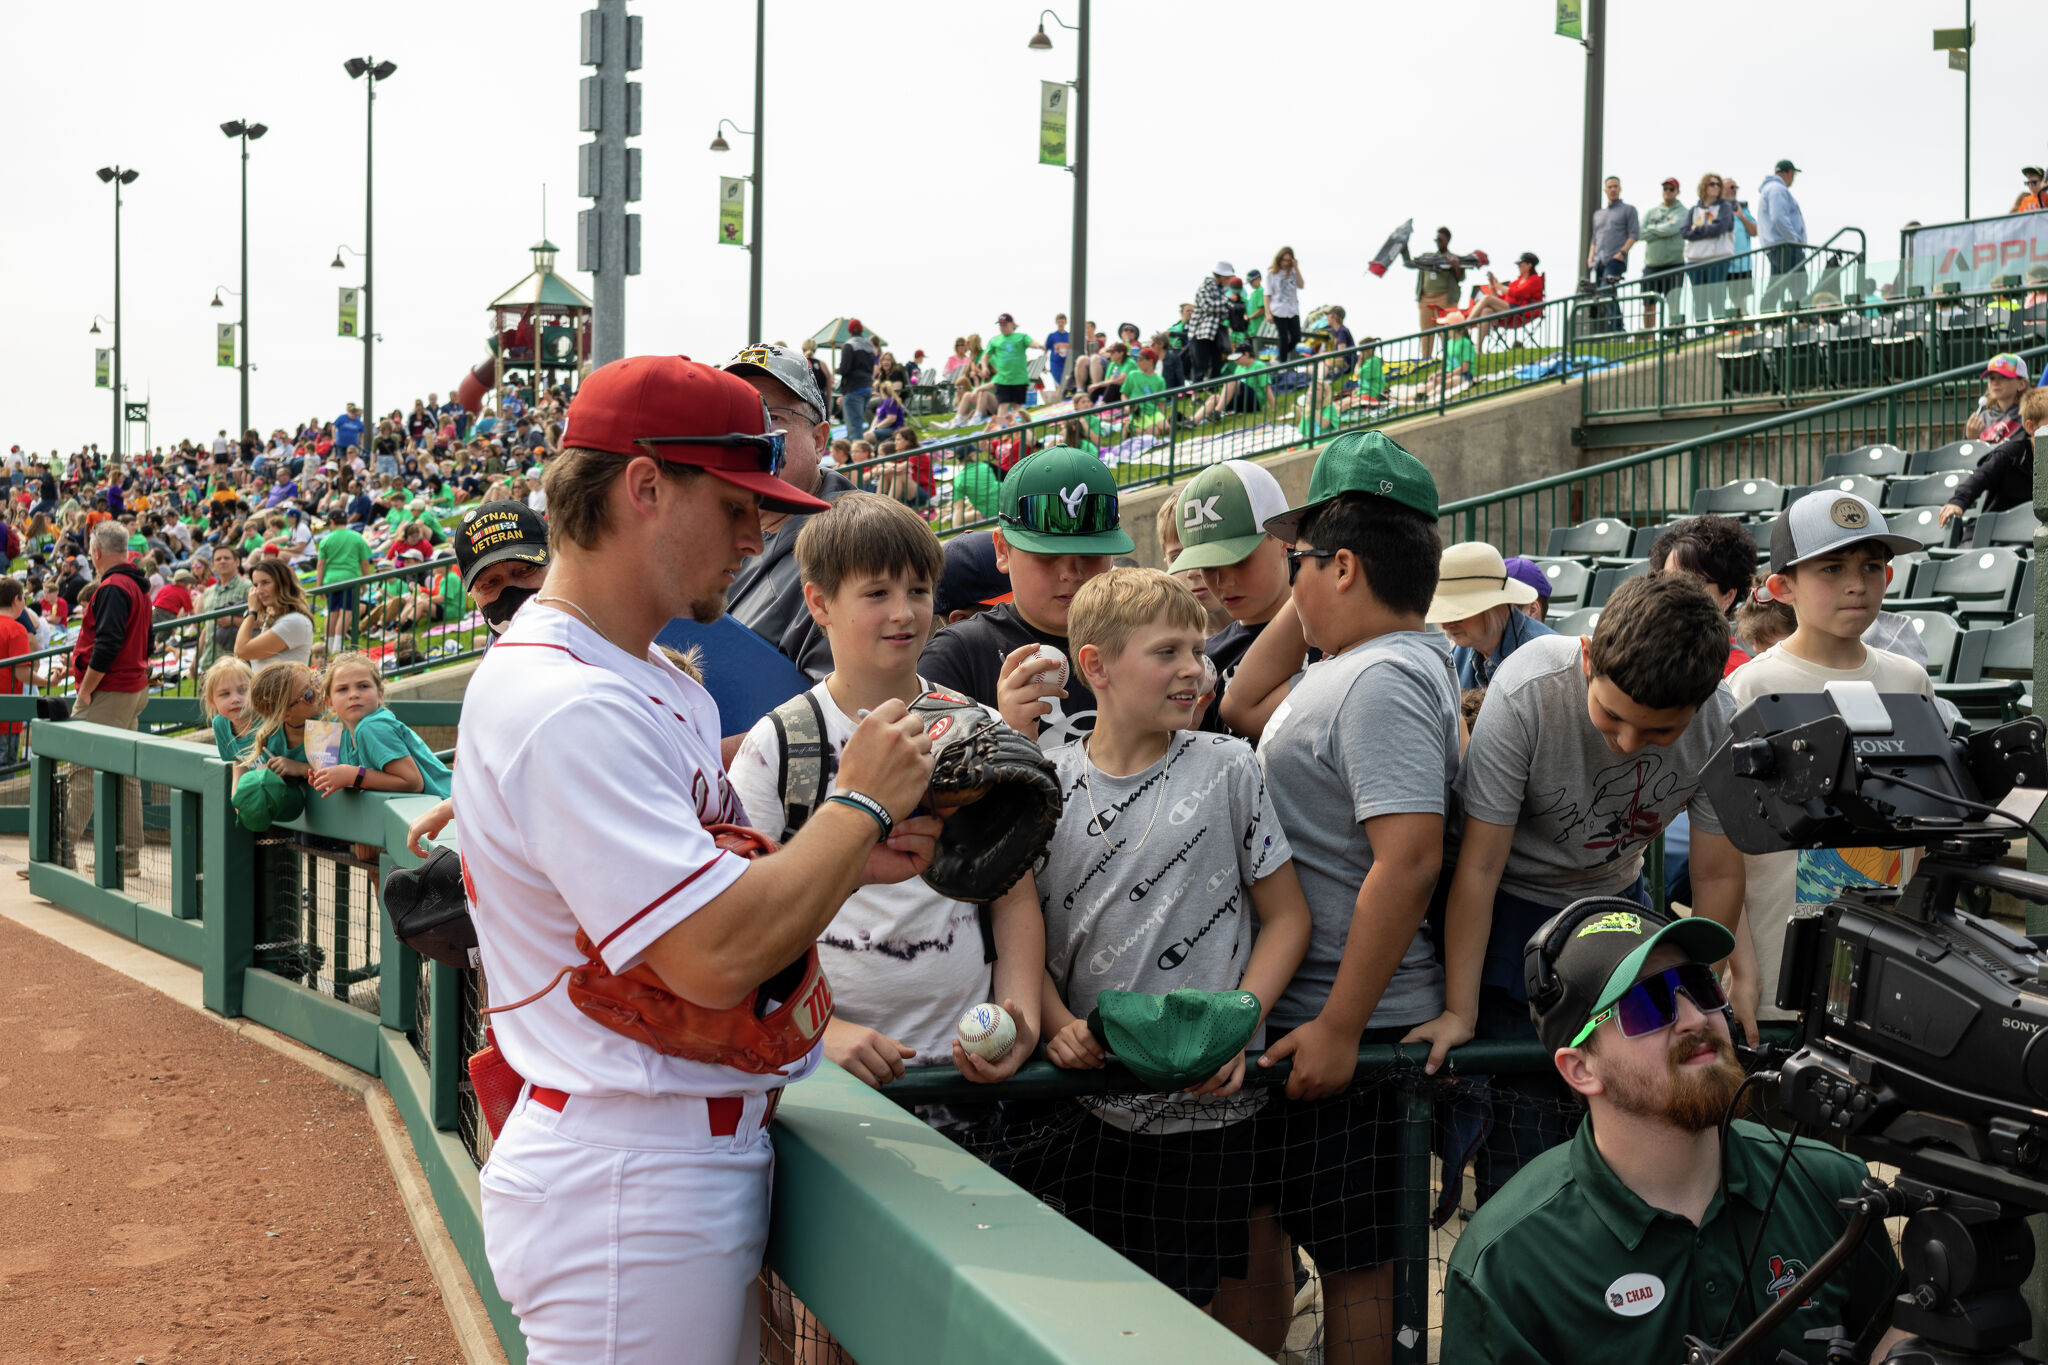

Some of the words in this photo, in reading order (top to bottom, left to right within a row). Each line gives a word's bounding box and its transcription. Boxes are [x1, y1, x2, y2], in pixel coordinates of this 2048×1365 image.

[465, 511, 519, 537] VIETNAM
[1184, 494, 1224, 529] DK
[472, 529, 524, 555] VETERAN
[1853, 739, 1905, 753] SONY
[849, 790, 882, 814] PROVERBS
[1128, 825, 1208, 902] Champion
[1089, 872, 1197, 976] Champion
[2001, 1017, 2040, 1033] SONY
[1625, 1286, 1654, 1304] CHAD
